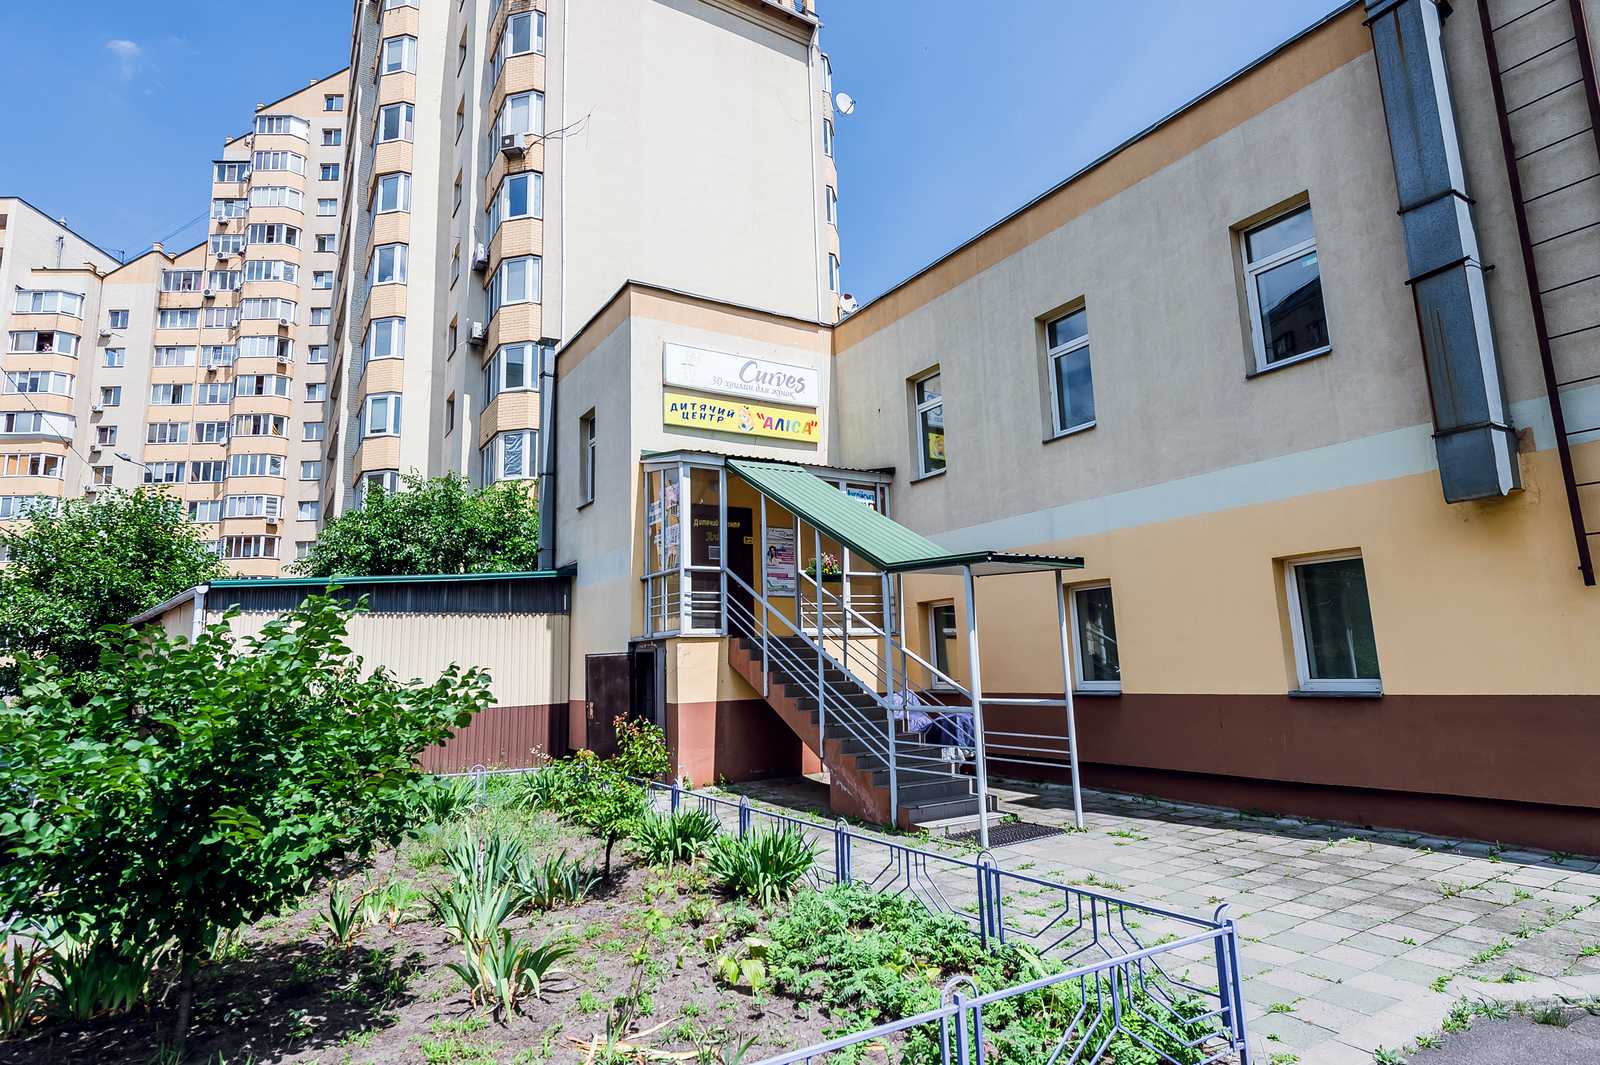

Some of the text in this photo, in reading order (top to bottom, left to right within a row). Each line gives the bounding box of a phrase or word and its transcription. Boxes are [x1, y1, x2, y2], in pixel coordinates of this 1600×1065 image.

[712, 375, 723, 387] 30
[738, 359, 806, 394] Curves
[670, 402, 735, 418] ДИТЯЧИЙ
[682, 411, 725, 423] ЦЕНТР
[757, 412, 818, 436] "АЛІСА"
